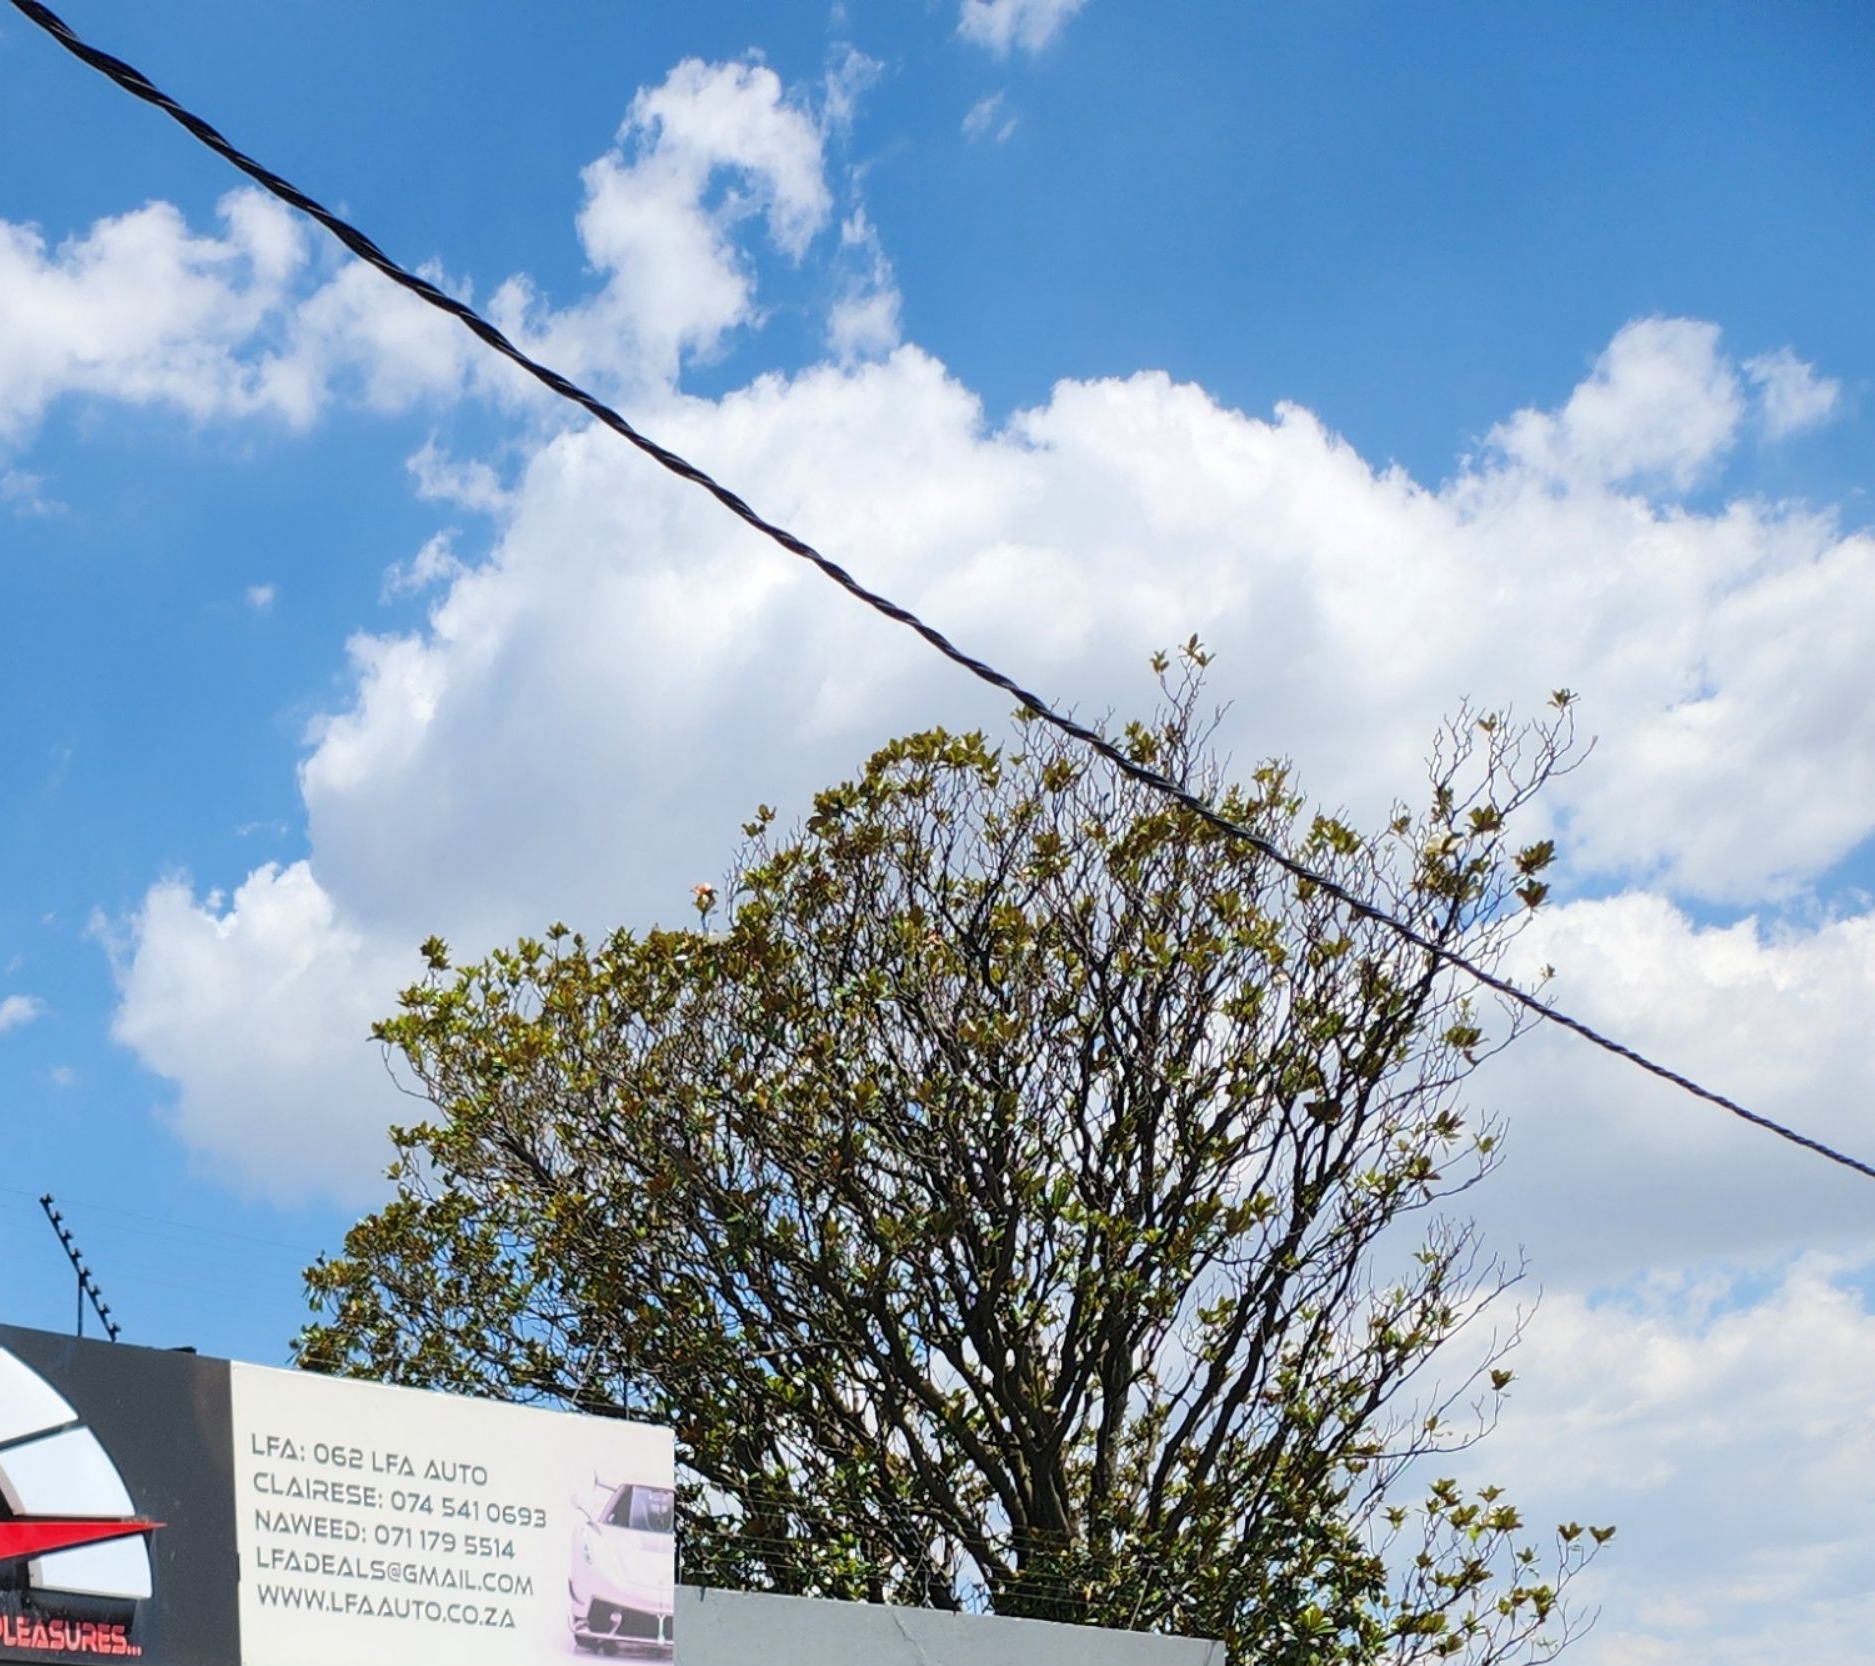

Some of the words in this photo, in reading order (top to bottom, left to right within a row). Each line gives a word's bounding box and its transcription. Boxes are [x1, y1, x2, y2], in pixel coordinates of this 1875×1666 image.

[251, 1432, 306, 1462] LFA:
[313, 1443, 364, 1470] 062
[371, 1450, 415, 1479] LFA
[422, 1459, 489, 1487] AUTO
[252, 1471, 384, 1510] CLAIRESE:
[390, 1490, 435, 1515] 074
[441, 1498, 480, 1522] 541
[486, 1503, 547, 1529] 0693
[254, 1509, 367, 1544] NAWEED:
[374, 1525, 412, 1549] 071
[419, 1530, 457, 1554] 179
[464, 1535, 517, 1560] 5514
[256, 1546, 534, 1597] LFADEALS@GMAIL.COM
[257, 1584, 517, 1629] WWW.LFAAUTO.CO.ZA
